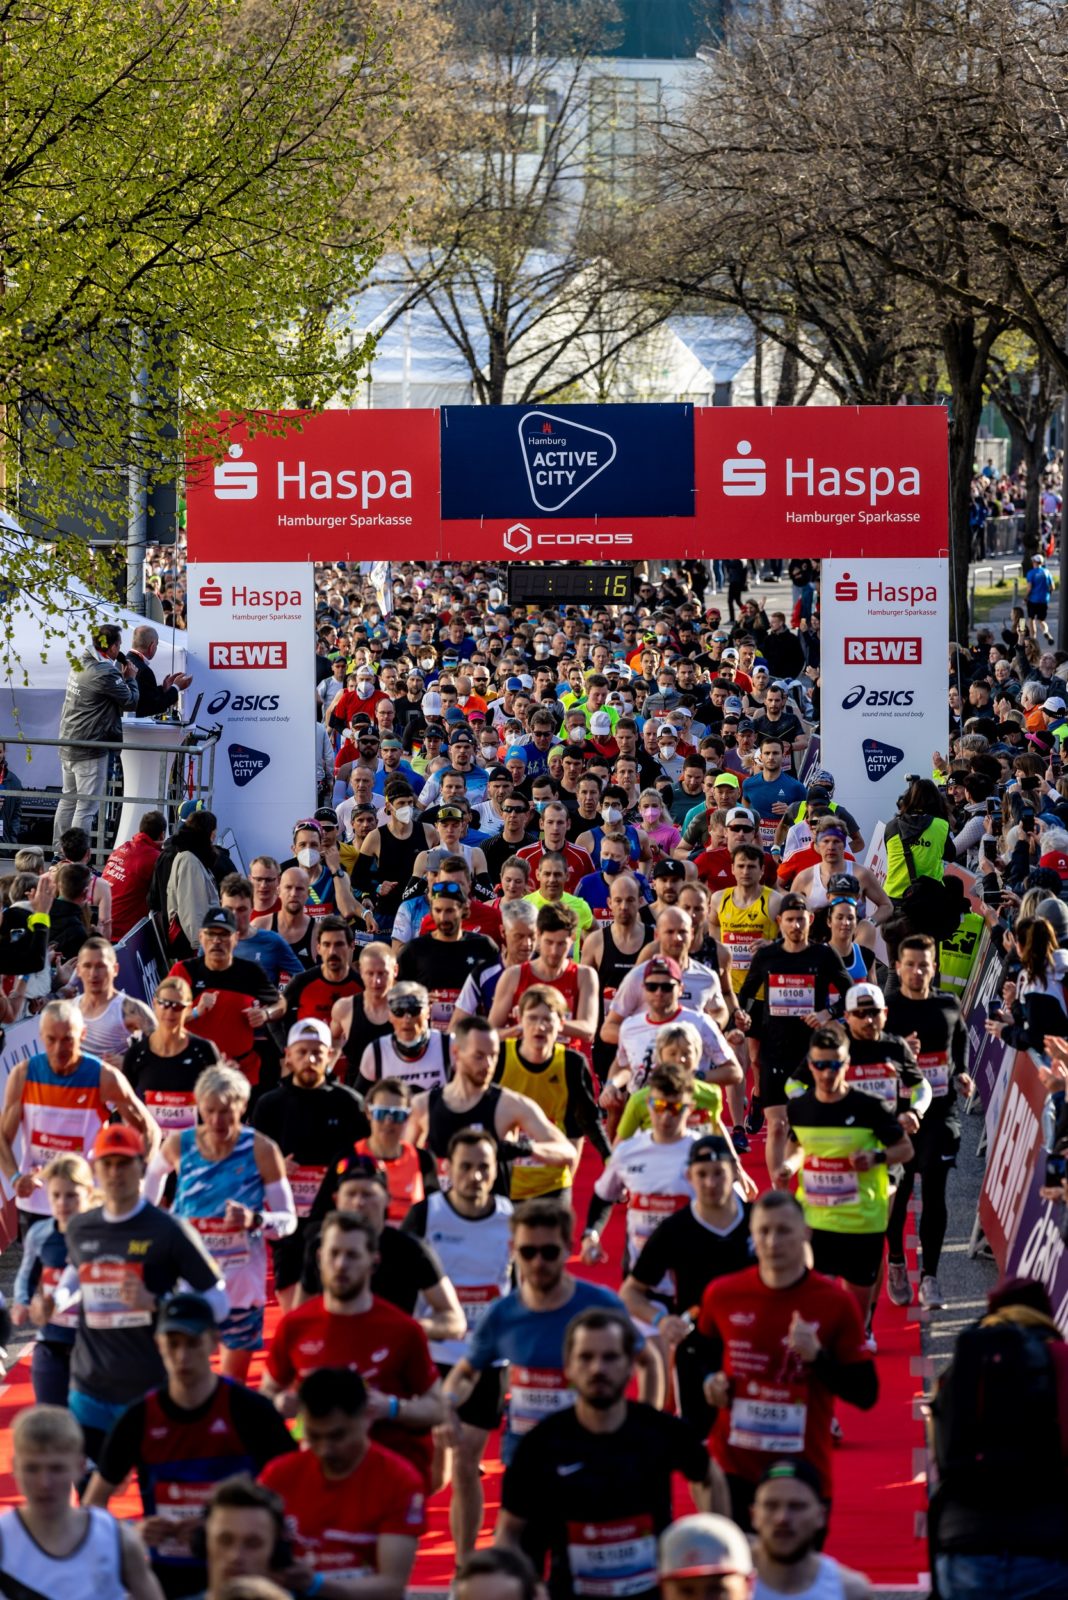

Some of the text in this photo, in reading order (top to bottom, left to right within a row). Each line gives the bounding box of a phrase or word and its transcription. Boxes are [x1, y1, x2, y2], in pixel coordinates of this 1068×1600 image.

[528, 437, 567, 446] Hamburg
[533, 452, 598, 466] ACTIVE
[277, 461, 413, 509] Haspa
[536, 471, 576, 485] CITY
[786, 458, 920, 506] Haspa
[277, 514, 413, 528] Hamburger Sparkasse
[786, 511, 920, 525] Hamburger Sparkasse
[537, 533, 633, 544] COROS
[232, 586, 302, 611] Haspa
[867, 582, 937, 606] Haspa
[269, 613, 302, 621] Sparkasse
[867, 609, 903, 617] Hamburger
[213, 646, 284, 666] REWE
[848, 641, 918, 661] REWE
[911, 711, 925, 719] body
[233, 760, 264, 768] ACTIVE
[867, 755, 897, 763] ACTIVE
[234, 769, 254, 777] CITY
[868, 764, 888, 772] CITY
[778, 989, 805, 998] 16108
[985, 1081, 1040, 1241] REWE
